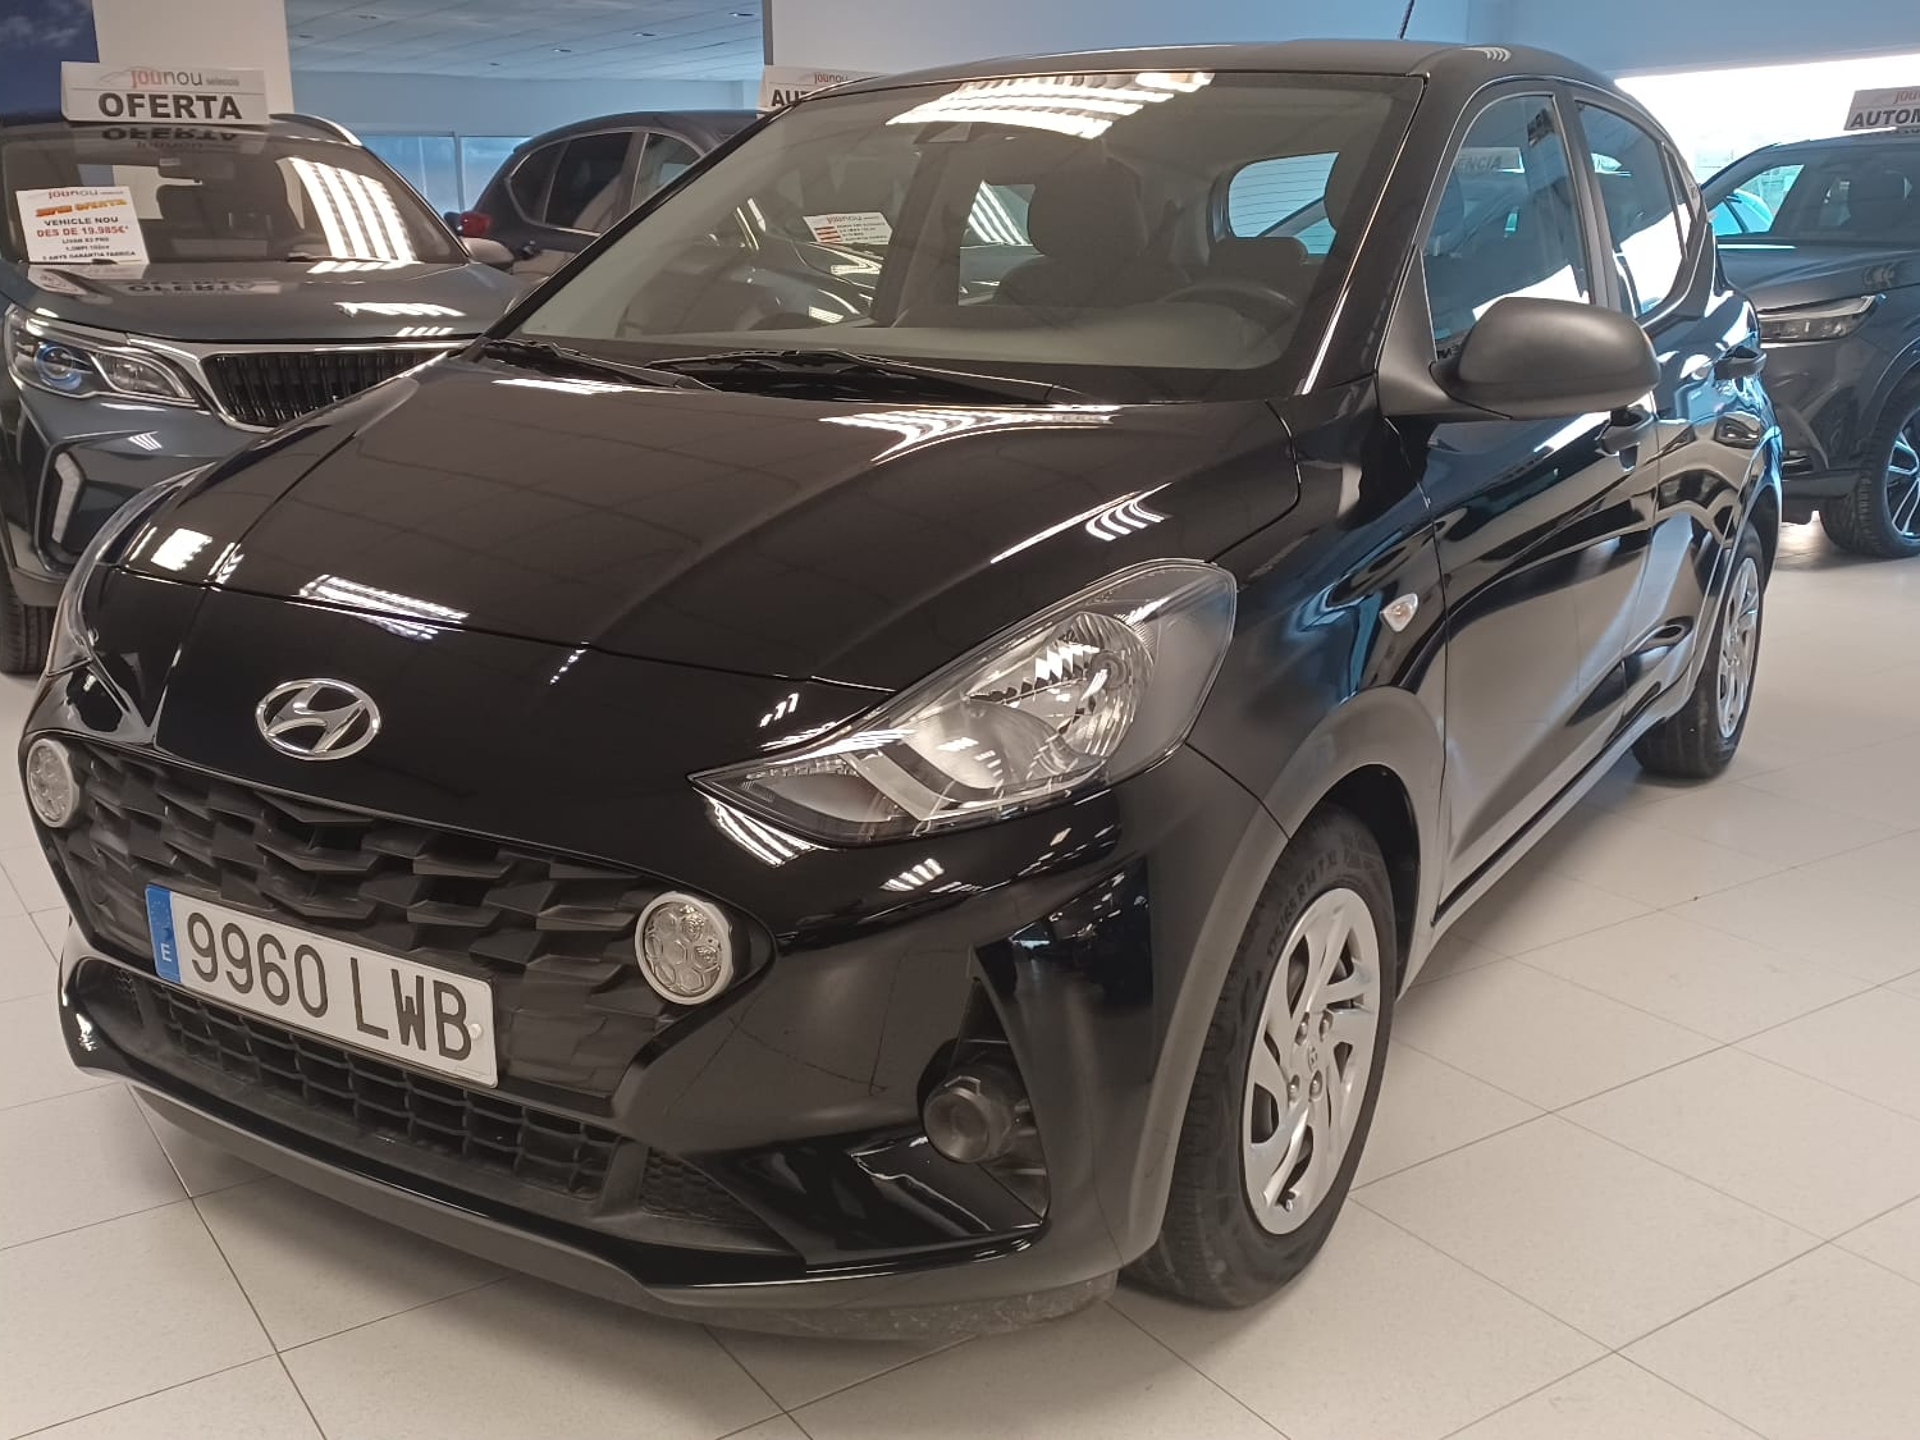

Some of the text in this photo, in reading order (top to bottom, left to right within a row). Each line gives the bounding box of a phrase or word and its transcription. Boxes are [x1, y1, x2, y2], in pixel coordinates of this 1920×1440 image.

[131, 70, 203, 88] jounou
[98, 92, 243, 119] OFERTA
[1893, 90, 1920, 104] jou
[44, 216, 119, 226] VEHICLE NOU
[37, 229, 59, 237] DES
[63, 228, 78, 236] DE
[162, 943, 172, 963] E
[187, 913, 472, 1061] 9960 LWB
